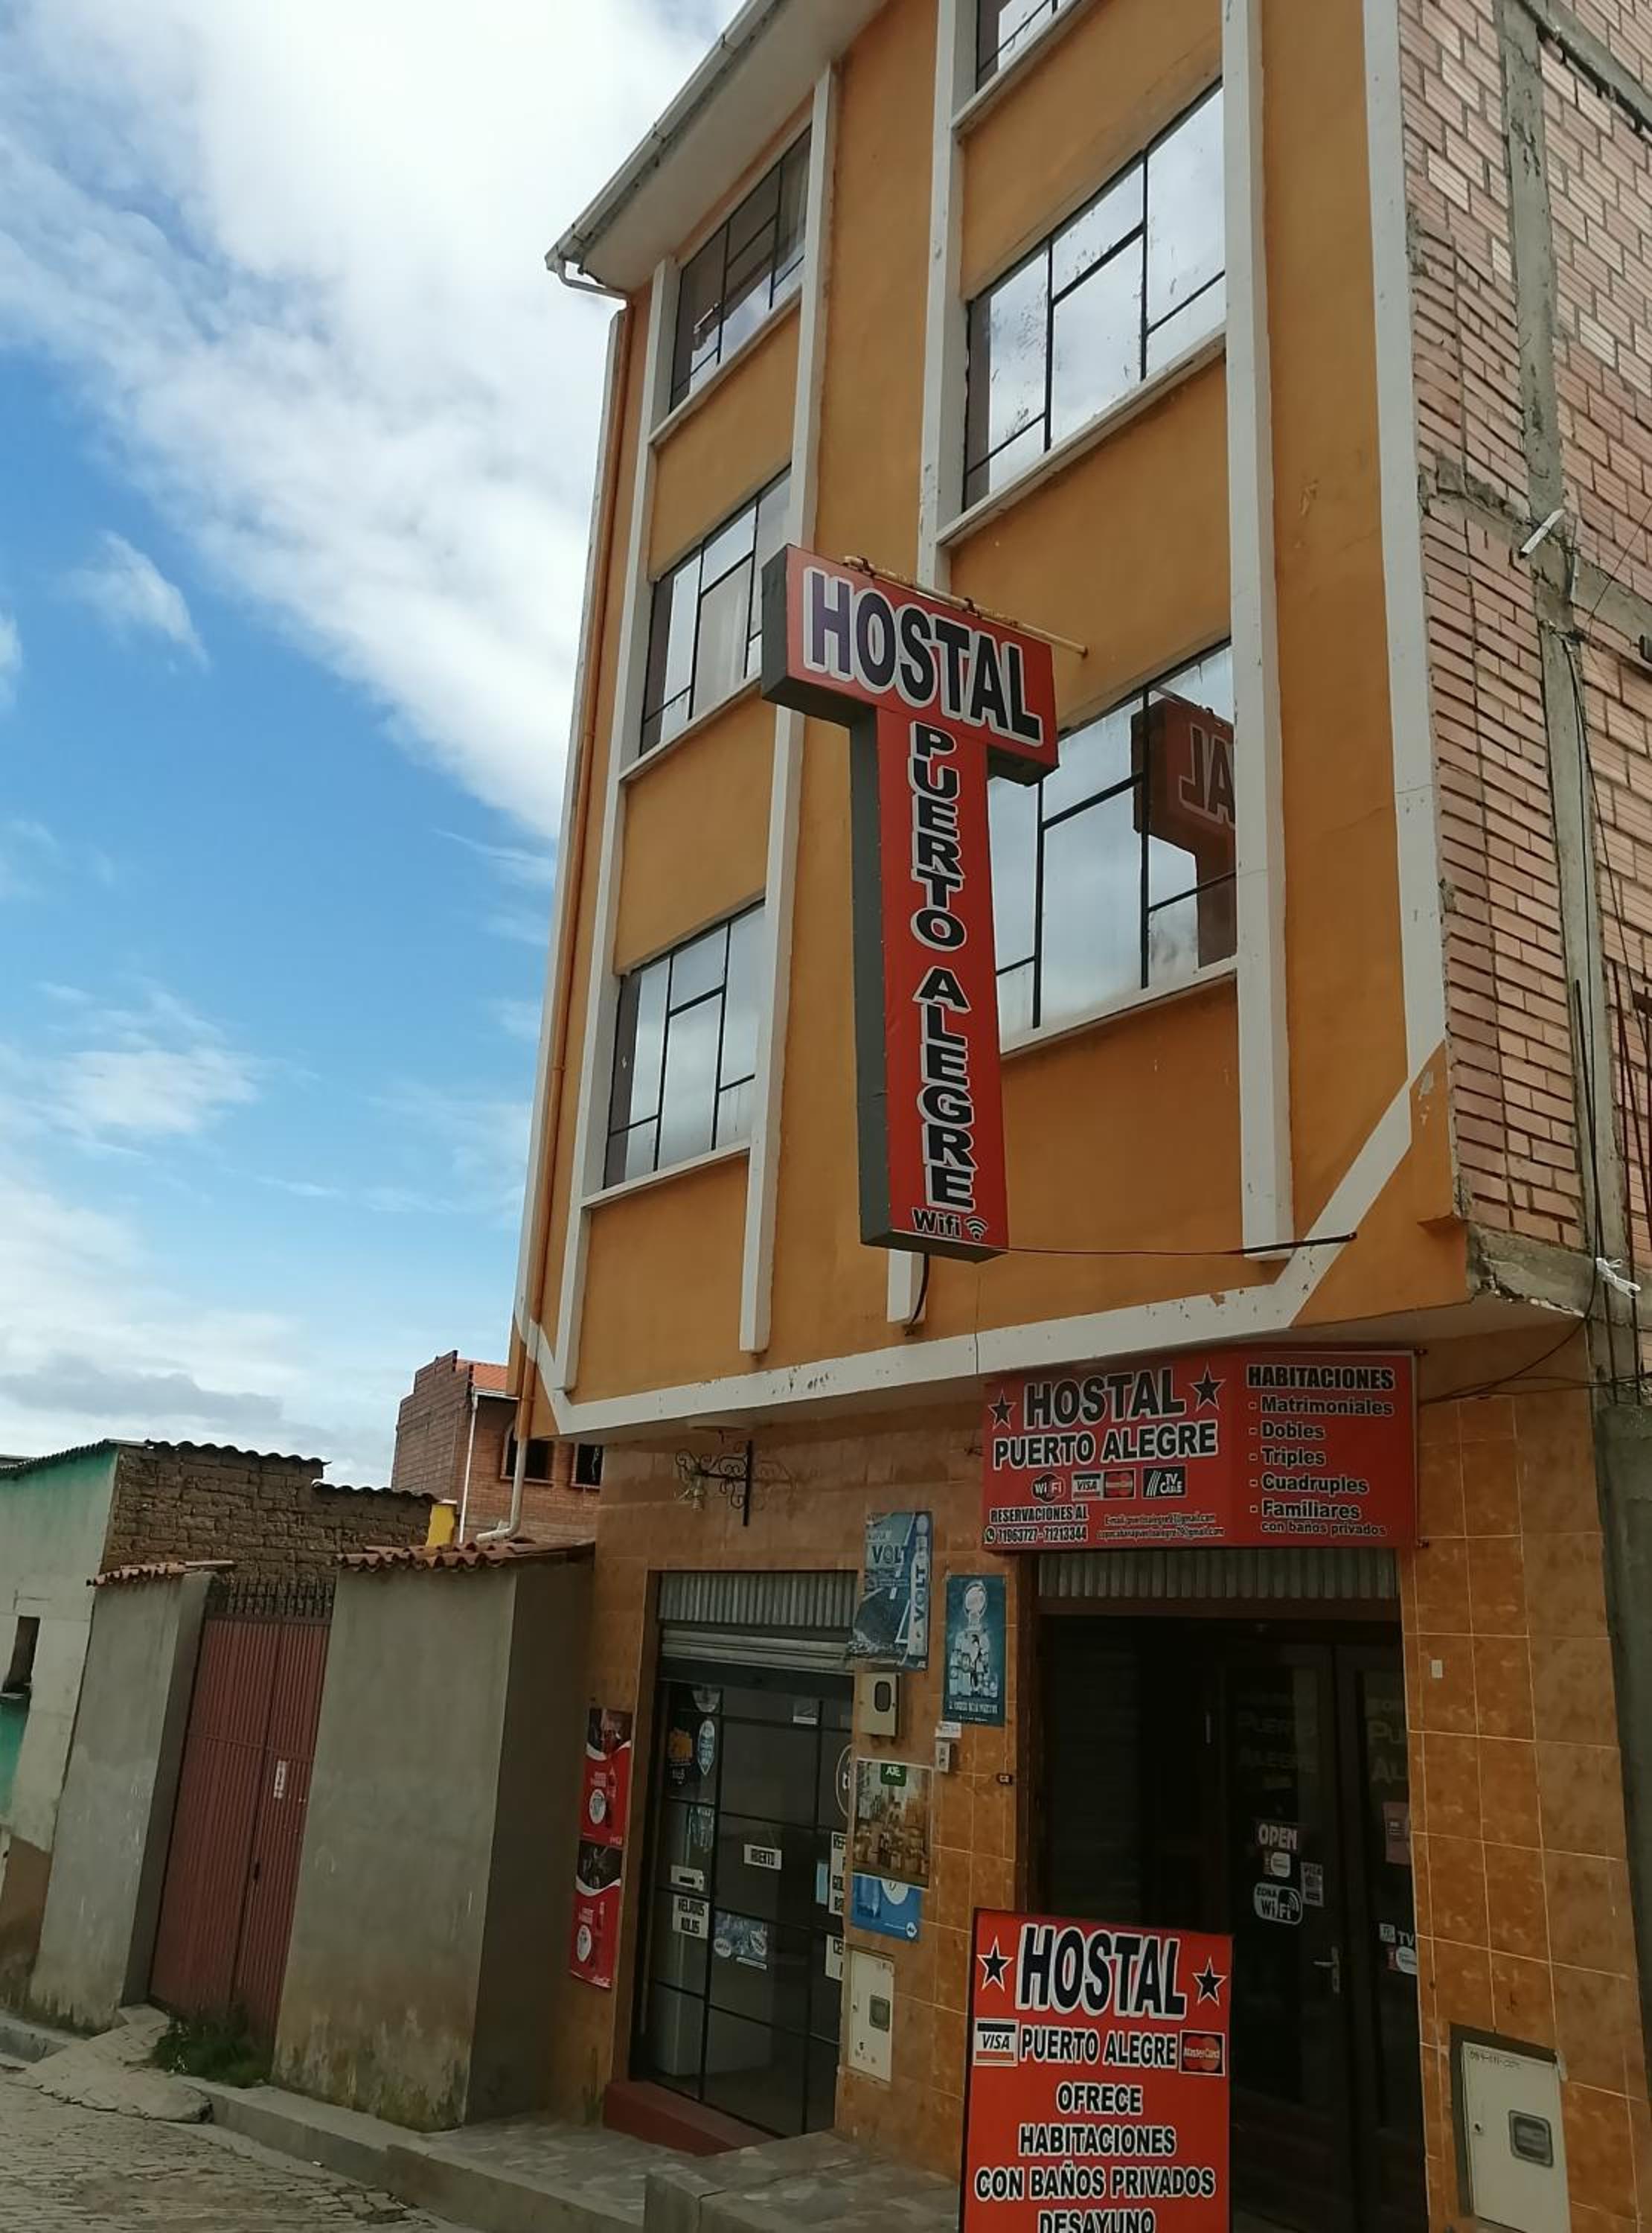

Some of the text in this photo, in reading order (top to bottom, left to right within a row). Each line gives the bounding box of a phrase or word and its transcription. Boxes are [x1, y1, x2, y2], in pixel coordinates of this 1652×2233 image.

[804, 566, 1043, 745] HOSTAL
[909, 721, 966, 951] PUERTO
[912, 966, 977, 1211] ALEGRE
[912, 1209, 963, 1239] Wifi
[1247, 1364, 1395, 1390] HABITACIONES
[1024, 1367, 1186, 1430] HOSTAL
[1261, 1395, 1394, 1416] Matrimoniales
[993, 1419, 1218, 1470] PUERTO ALEGRE
[1261, 1419, 1325, 1440] Dobles
[1261, 1445, 1327, 1470] Triples
[1261, 1473, 1369, 1497] Cuadruples
[990, 1505, 1073, 1524] RESERVACIONES
[1262, 1498, 1362, 1520] Familiares
[1258, 1824, 1297, 1850] OPEN
[1016, 1923, 1187, 2021] HOSTAL
[982, 2033, 1010, 2049] VISA
[1020, 2025, 1177, 2069] PUERTO ALEGRE
[1057, 2081, 1144, 2115] OFRECE
[1018, 2123, 1176, 2157] HABITACIONES
[975, 2160, 1216, 2201] CON BAÑOS PRIVADOS
[1039, 2208, 1155, 2233] DESAYUNO
